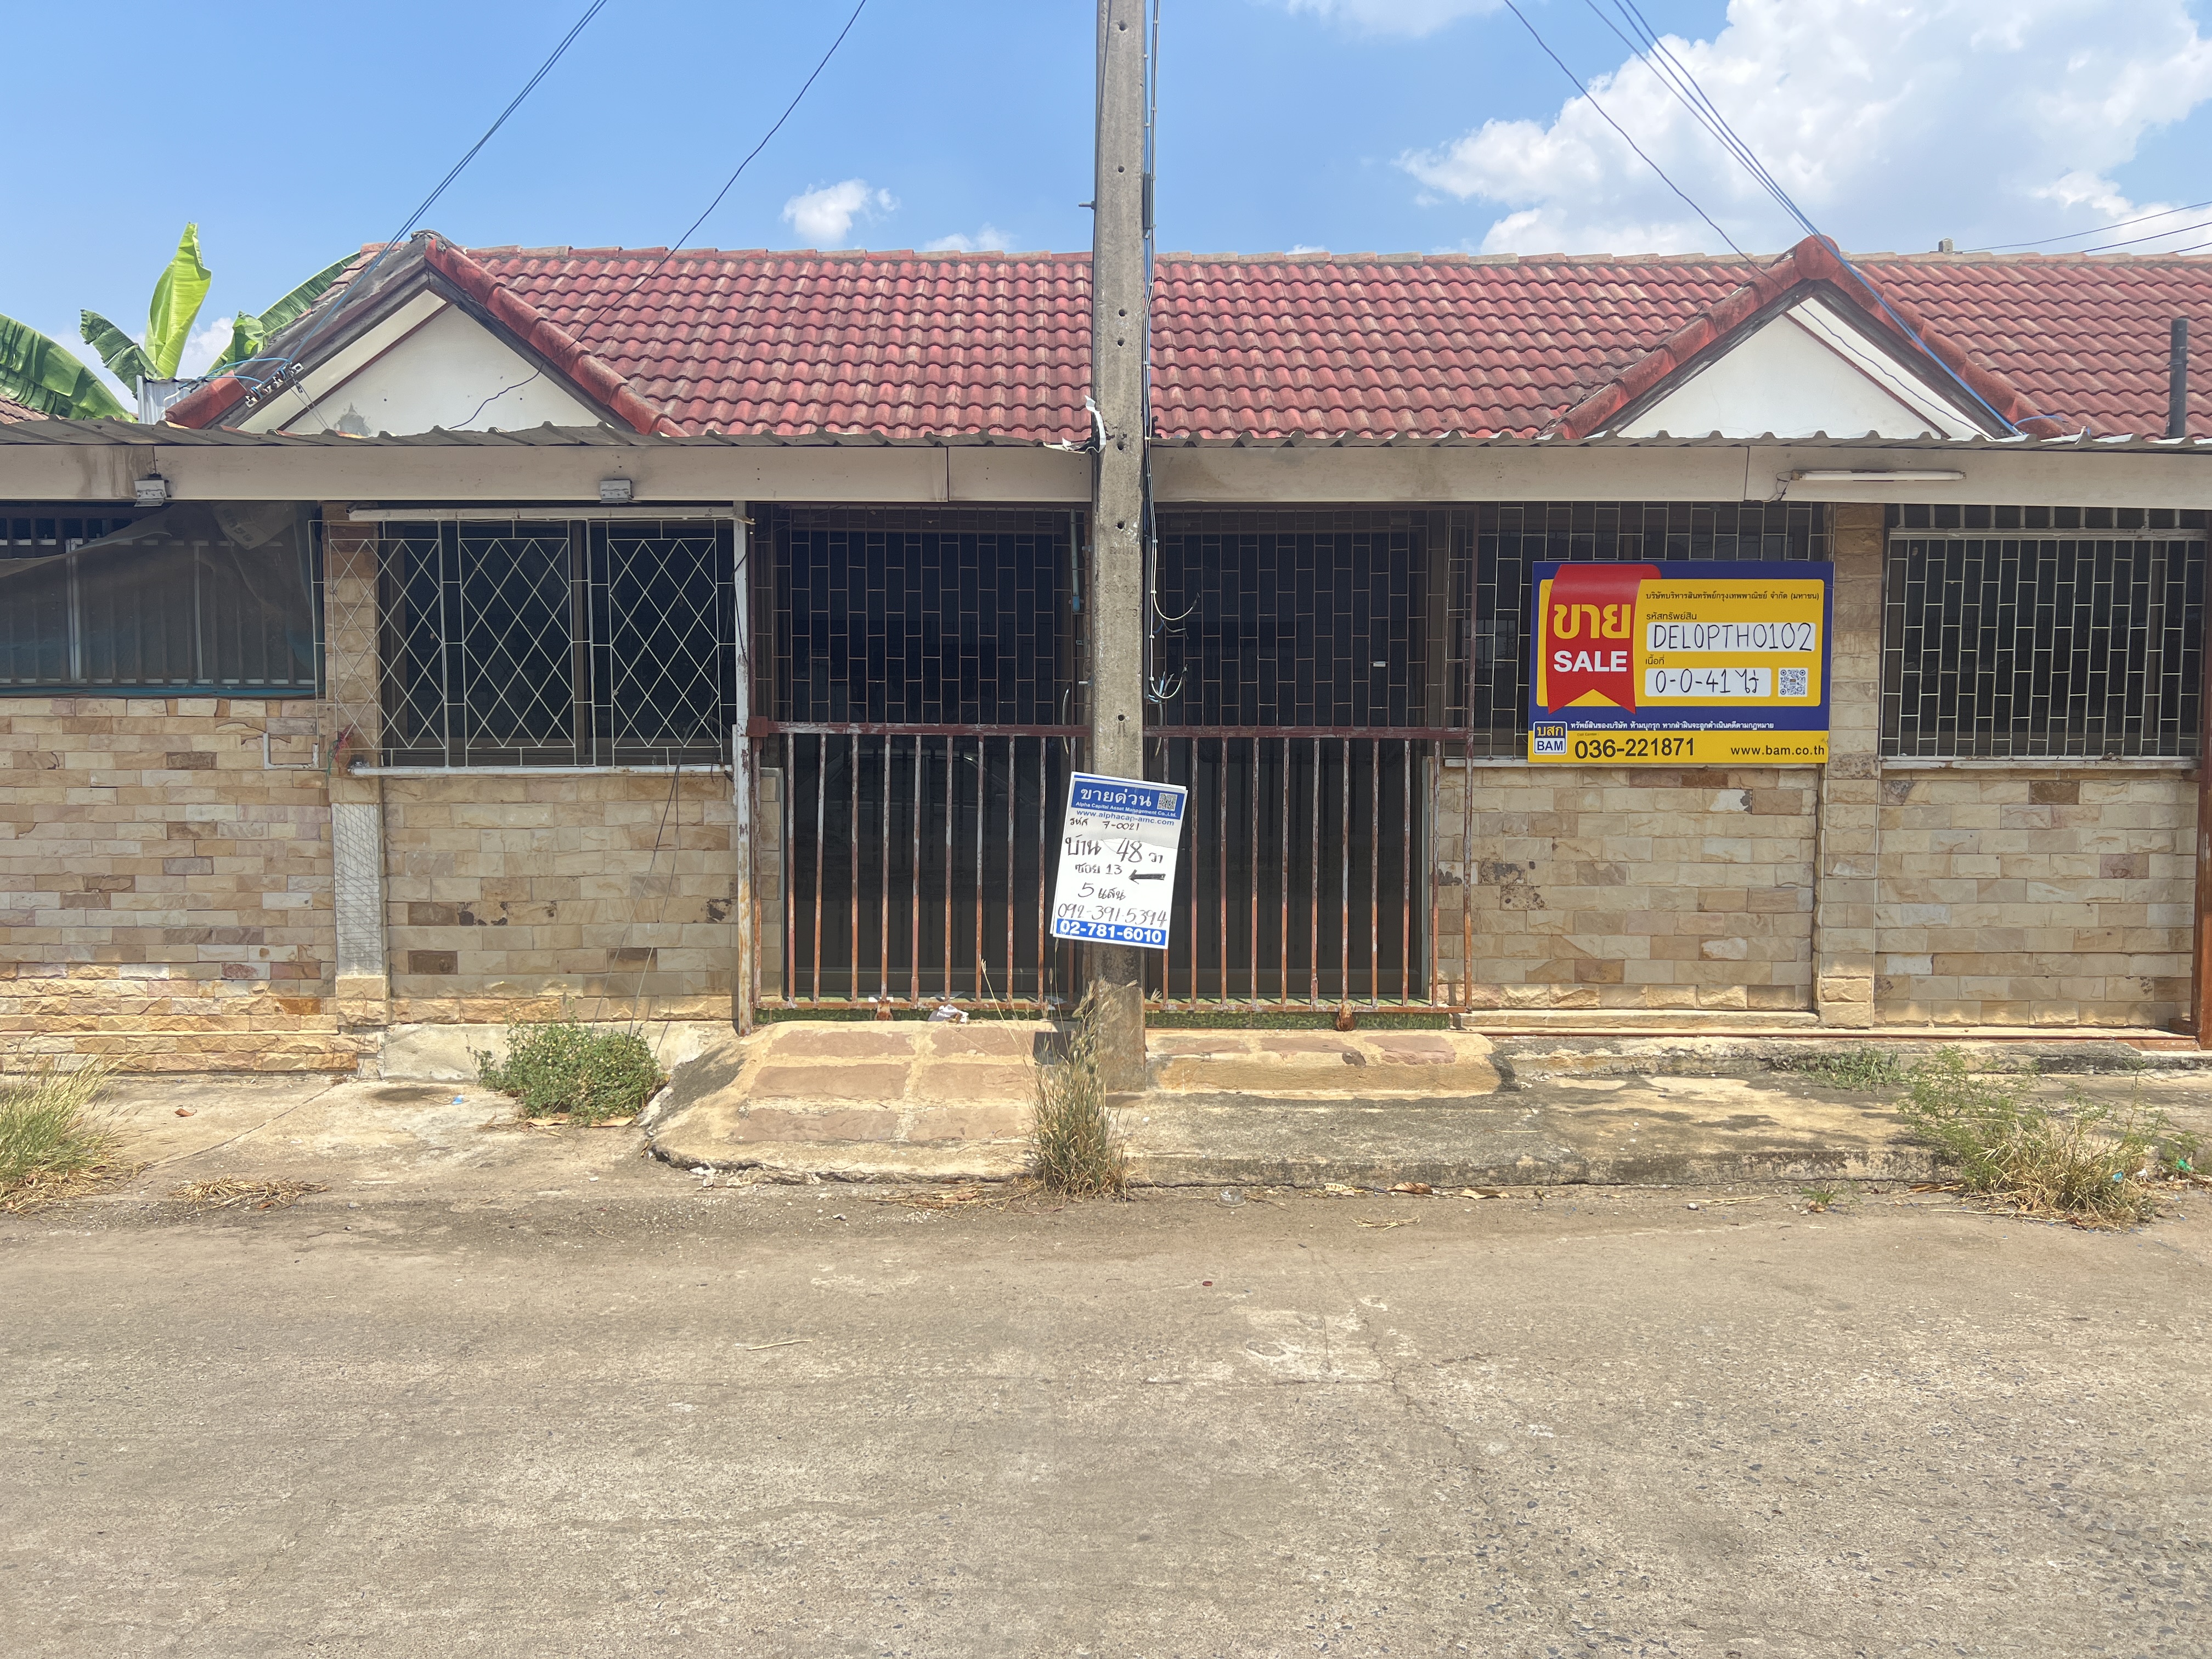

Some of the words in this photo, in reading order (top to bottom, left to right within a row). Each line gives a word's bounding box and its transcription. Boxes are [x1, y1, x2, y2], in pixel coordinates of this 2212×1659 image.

[1791, 592, 1820, 601] (มหาชน)
[1553, 603, 1632, 640] ขาย
[1646, 611, 1697, 620] รหัสทรัพย์สิน
[1553, 650, 1628, 673] SALE
[1645, 654, 1665, 665] เนื้อที่
[1656, 668, 1731, 693] 0-0-41
[1537, 725, 1564, 737] บสก
[1630, 721, 1660, 731] ห้ามบุกรุก
[1537, 740, 1564, 751] BAM
[1575, 737, 1694, 759] 036-221871
[1730, 745, 1825, 755] www.bam.co.th
[1080, 788, 1152, 807] ขายด่วน
[1125, 806, 1157, 815] Management
[1076, 810, 1175, 826] www.alphacap-amc.com
[1116, 838, 1143, 863] 48
[1105, 864, 1122, 875] 13
[1077, 882, 1094, 898] 5
[1059, 919, 1163, 944] 02-781-6010
